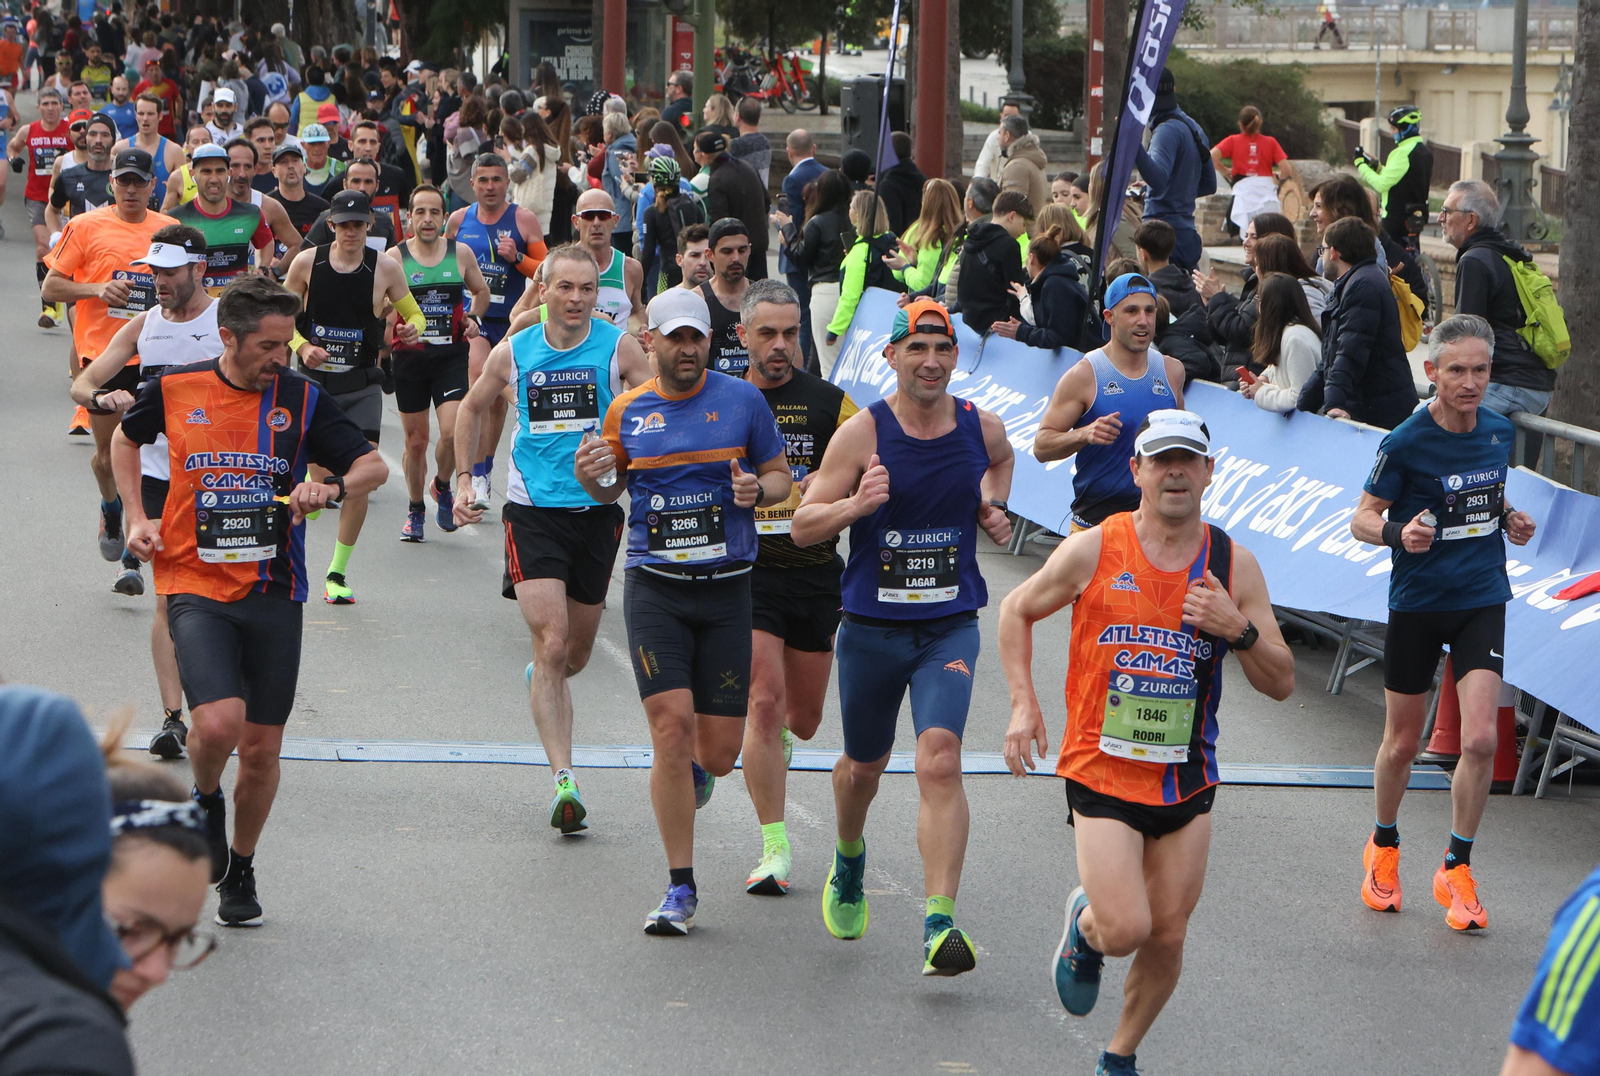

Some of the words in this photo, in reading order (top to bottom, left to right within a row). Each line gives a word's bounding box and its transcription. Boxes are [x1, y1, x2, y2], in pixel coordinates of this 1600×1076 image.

[557, 27, 583, 36] prime
[584, 27, 592, 35] vi
[1140, 0, 1172, 68] asi
[560, 57, 593, 69] TEMPORA
[31, 137, 51, 146] COSTA
[52, 136, 68, 146] RICA
[480, 262, 505, 272] ZURICH
[130, 275, 154, 284] ZURIC
[129, 290, 146, 299] 2988
[328, 330, 358, 338] ZURICH
[326, 344, 345, 352] 2447
[551, 372, 588, 382] ZURICH
[551, 392, 574, 404] 3157
[553, 409, 576, 419] DAVID
[782, 433, 814, 441] TANES
[184, 452, 290, 475] ATLETISMO
[201, 472, 274, 490] CAMAS
[1466, 469, 1499, 485] ZURICH
[223, 492, 269, 505] ZURICH
[669, 492, 713, 506] ZURICH
[1466, 494, 1488, 507] 2931
[1465, 511, 1491, 523] FRANK
[222, 517, 251, 530] 2920
[671, 517, 698, 531] 3266
[216, 536, 259, 547] MARCIAL
[665, 534, 709, 548] CAMACHO
[907, 532, 952, 544] ZURICH
[907, 557, 935, 570] 3219
[905, 577, 936, 587] LAGAR
[1097, 624, 1212, 660] ATLETISMO
[1113, 649, 1195, 679] CAMAS
[1139, 681, 1190, 695] ZURICH
[1136, 707, 1168, 723] 1846
[1132, 729, 1166, 743] RODRI
